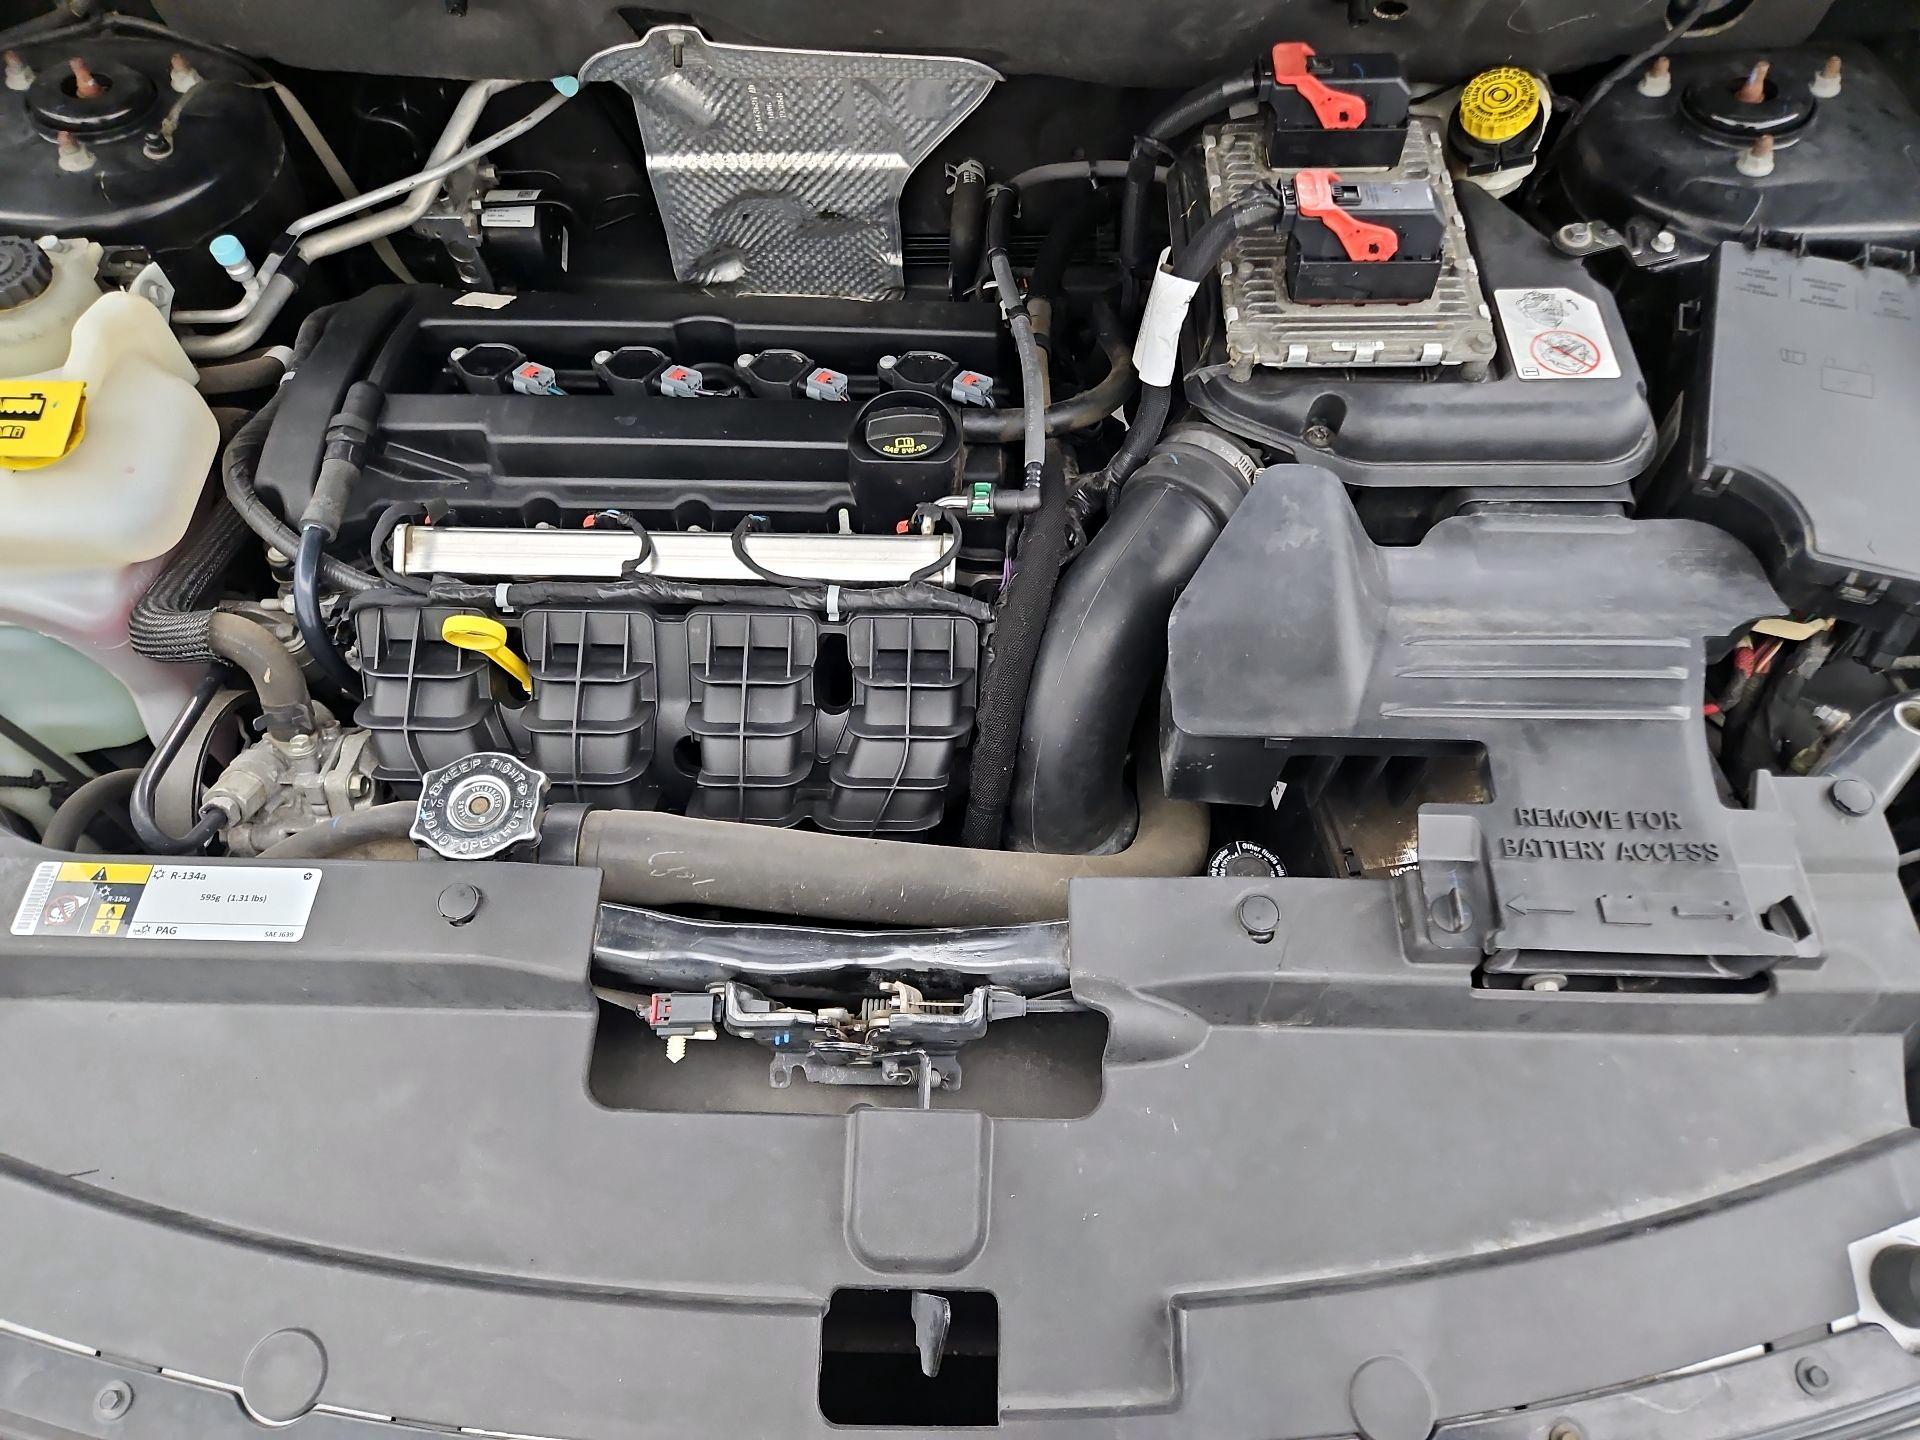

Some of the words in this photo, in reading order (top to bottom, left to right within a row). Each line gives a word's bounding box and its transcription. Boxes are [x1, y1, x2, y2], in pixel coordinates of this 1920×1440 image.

[883, 445, 900, 454] SAE
[901, 443, 928, 454] 5W-20
[440, 758, 481, 784] KEEP
[490, 758, 526, 784] TIGHT
[423, 799, 445, 808] TVS
[1514, 807, 1623, 830] REMOVE
[1626, 810, 1683, 831] FOR
[459, 835, 500, 852] OPEN
[1500, 837, 1605, 861] BATTERY
[1615, 841, 1720, 863] ACCESS
[1242, 843, 1262, 852] Other
[1262, 849, 1279, 864] fluids
[1275, 864, 1286, 877] will
[170, 871, 207, 880] R-134a
[106, 895, 131, 903] R-134a
[200, 893, 221, 903] 595g
[227, 894, 249, 903] (1.31
[251, 894, 268, 903] lbs)
[155, 926, 178, 935] PAG
